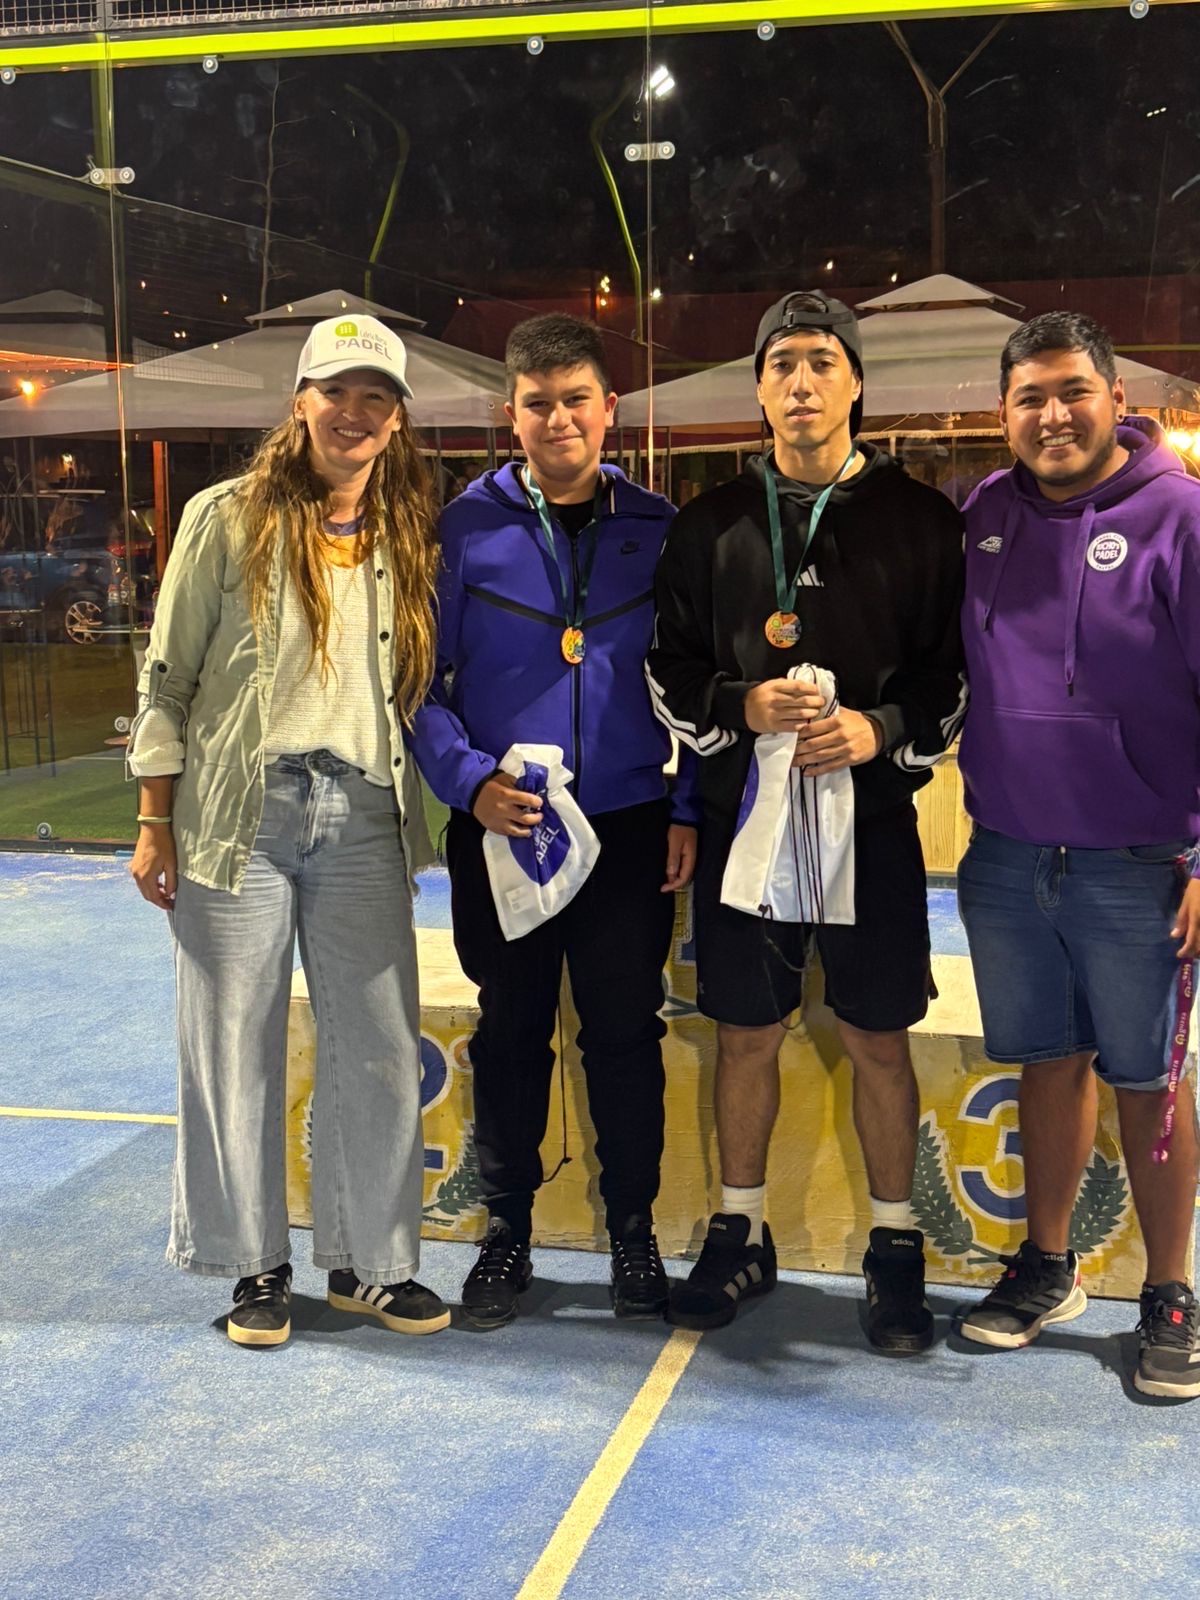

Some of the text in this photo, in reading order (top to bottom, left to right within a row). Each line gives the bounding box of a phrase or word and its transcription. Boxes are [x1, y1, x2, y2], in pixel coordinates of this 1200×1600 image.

[335, 338, 393, 361] PADEL
[1094, 549, 1119, 560] PADEL
[535, 826, 560, 865] ADEL
[891, 1238, 915, 1247] adidas
